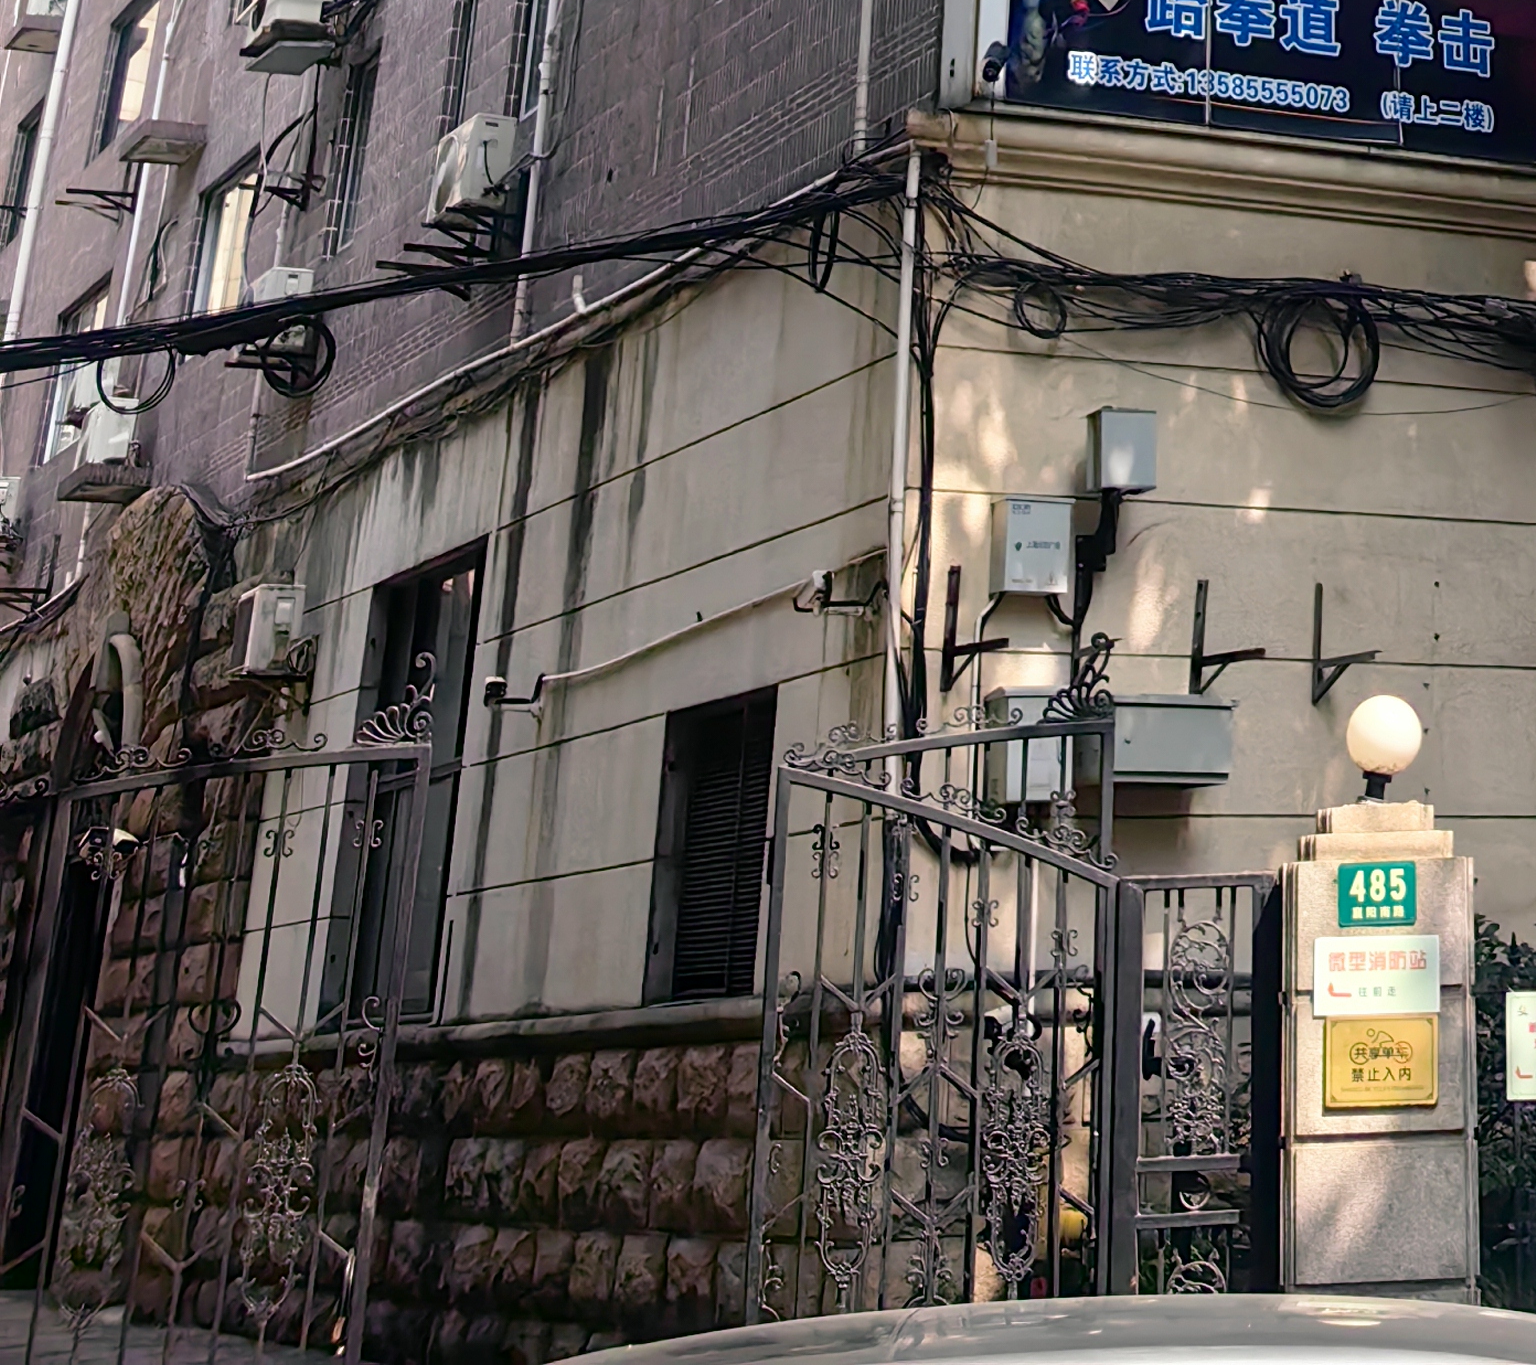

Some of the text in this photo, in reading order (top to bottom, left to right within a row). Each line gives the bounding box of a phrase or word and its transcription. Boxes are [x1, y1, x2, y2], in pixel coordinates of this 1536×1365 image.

[1349, 868, 1407, 902] 485
[1328, 950, 1427, 972] 微型消防站
[1354, 1046, 1409, 1060] 共享单车
[1351, 1066, 1411, 1082] 禁止入内
